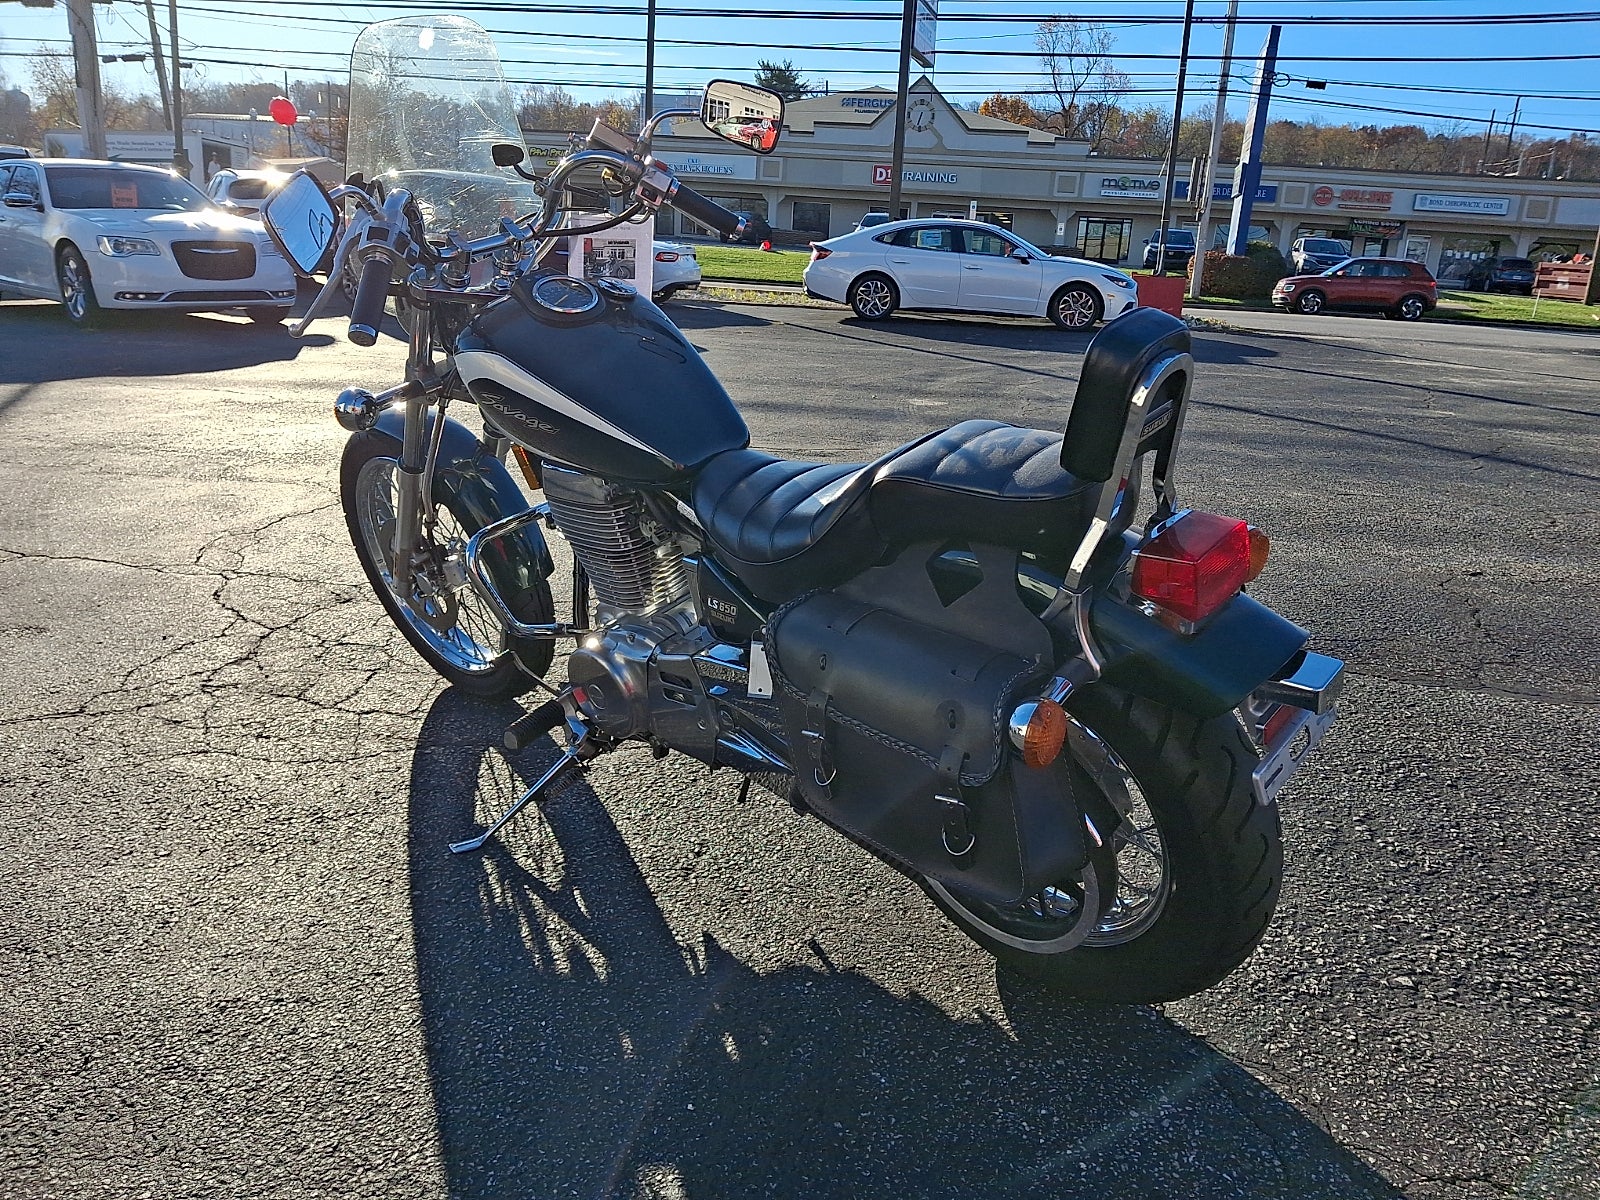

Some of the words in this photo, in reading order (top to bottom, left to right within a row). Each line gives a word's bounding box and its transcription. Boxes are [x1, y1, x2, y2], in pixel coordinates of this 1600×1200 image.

[851, 98, 896, 108] FERGUS
[530, 147, 547, 156] PAW
[696, 164, 733, 174] KITCHENS
[902, 171, 958, 183] TRAINING
[480, 391, 560, 435] Savage
[707, 597, 719, 610] LS
[719, 602, 737, 616] 650
[710, 610, 735, 625] SUZUKI
